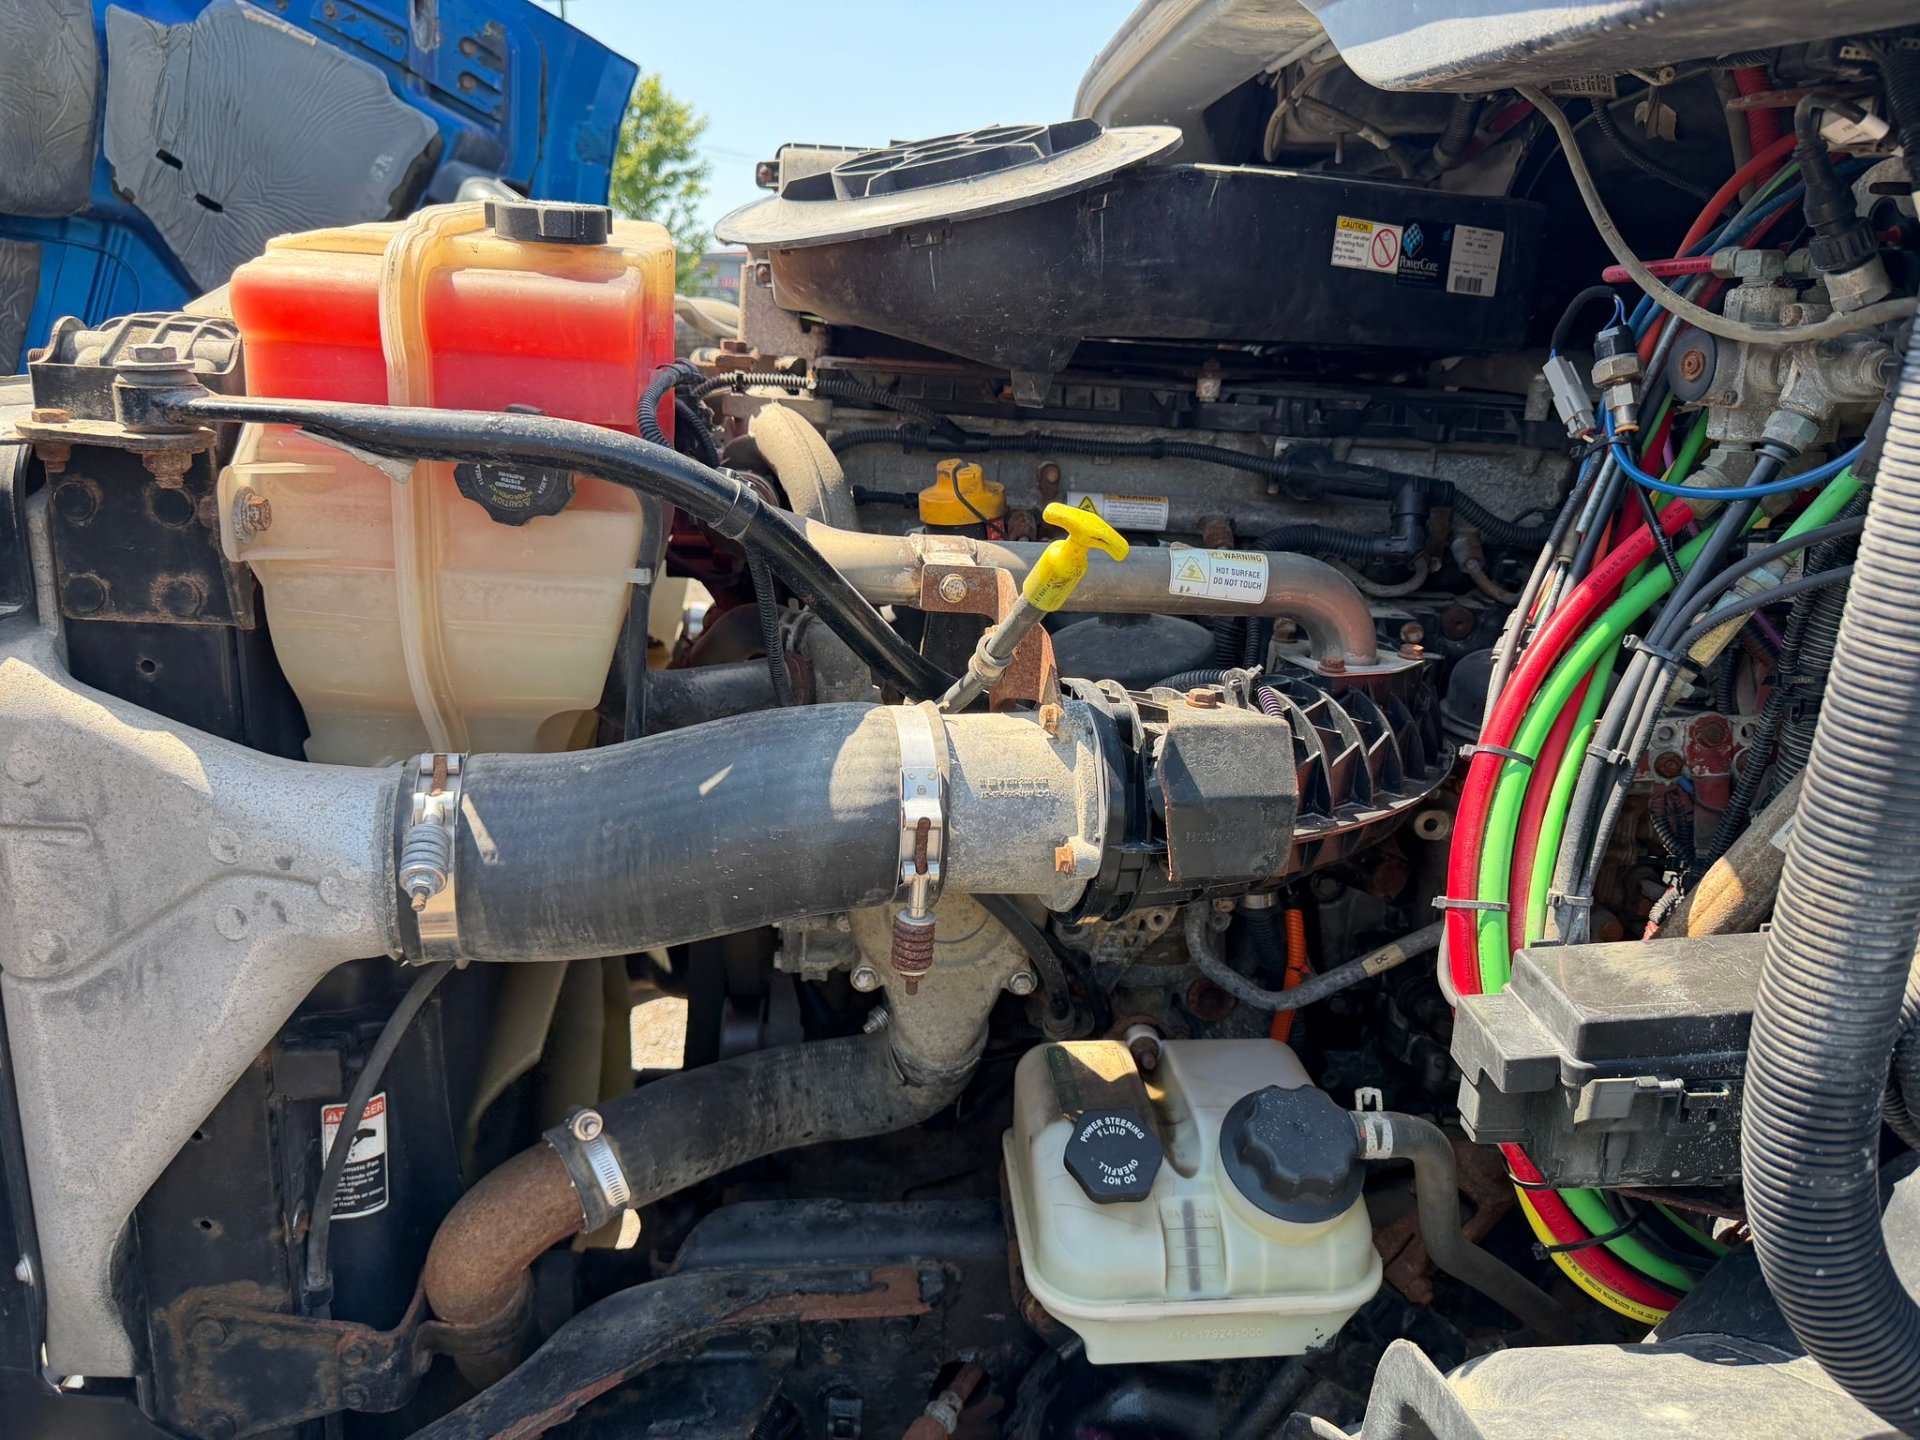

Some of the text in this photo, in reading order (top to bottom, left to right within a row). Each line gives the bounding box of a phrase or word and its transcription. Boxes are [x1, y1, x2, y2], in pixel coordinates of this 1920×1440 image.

[1341, 221, 1368, 231] CAUTION
[1400, 255, 1439, 272] PowerCore
[492, 494, 523, 508] CAUTION
[1223, 553, 1262, 562] WARNING
[1231, 568, 1260, 578] SURFACE
[1213, 576, 1262, 590] DO NOT TOUCH
[1080, 1116, 1145, 1143] POWER STEERING
[1097, 1125, 1126, 1138] FLUID
[367, 1160, 379, 1169] Fan
[1098, 1159, 1139, 1176] OVERFILL
[346, 1172, 366, 1181] hands
[366, 1168, 380, 1177] clear
[1102, 1174, 1137, 1185] DO NOT
[347, 1177, 368, 1187] engine
[342, 1193, 360, 1202] starts
